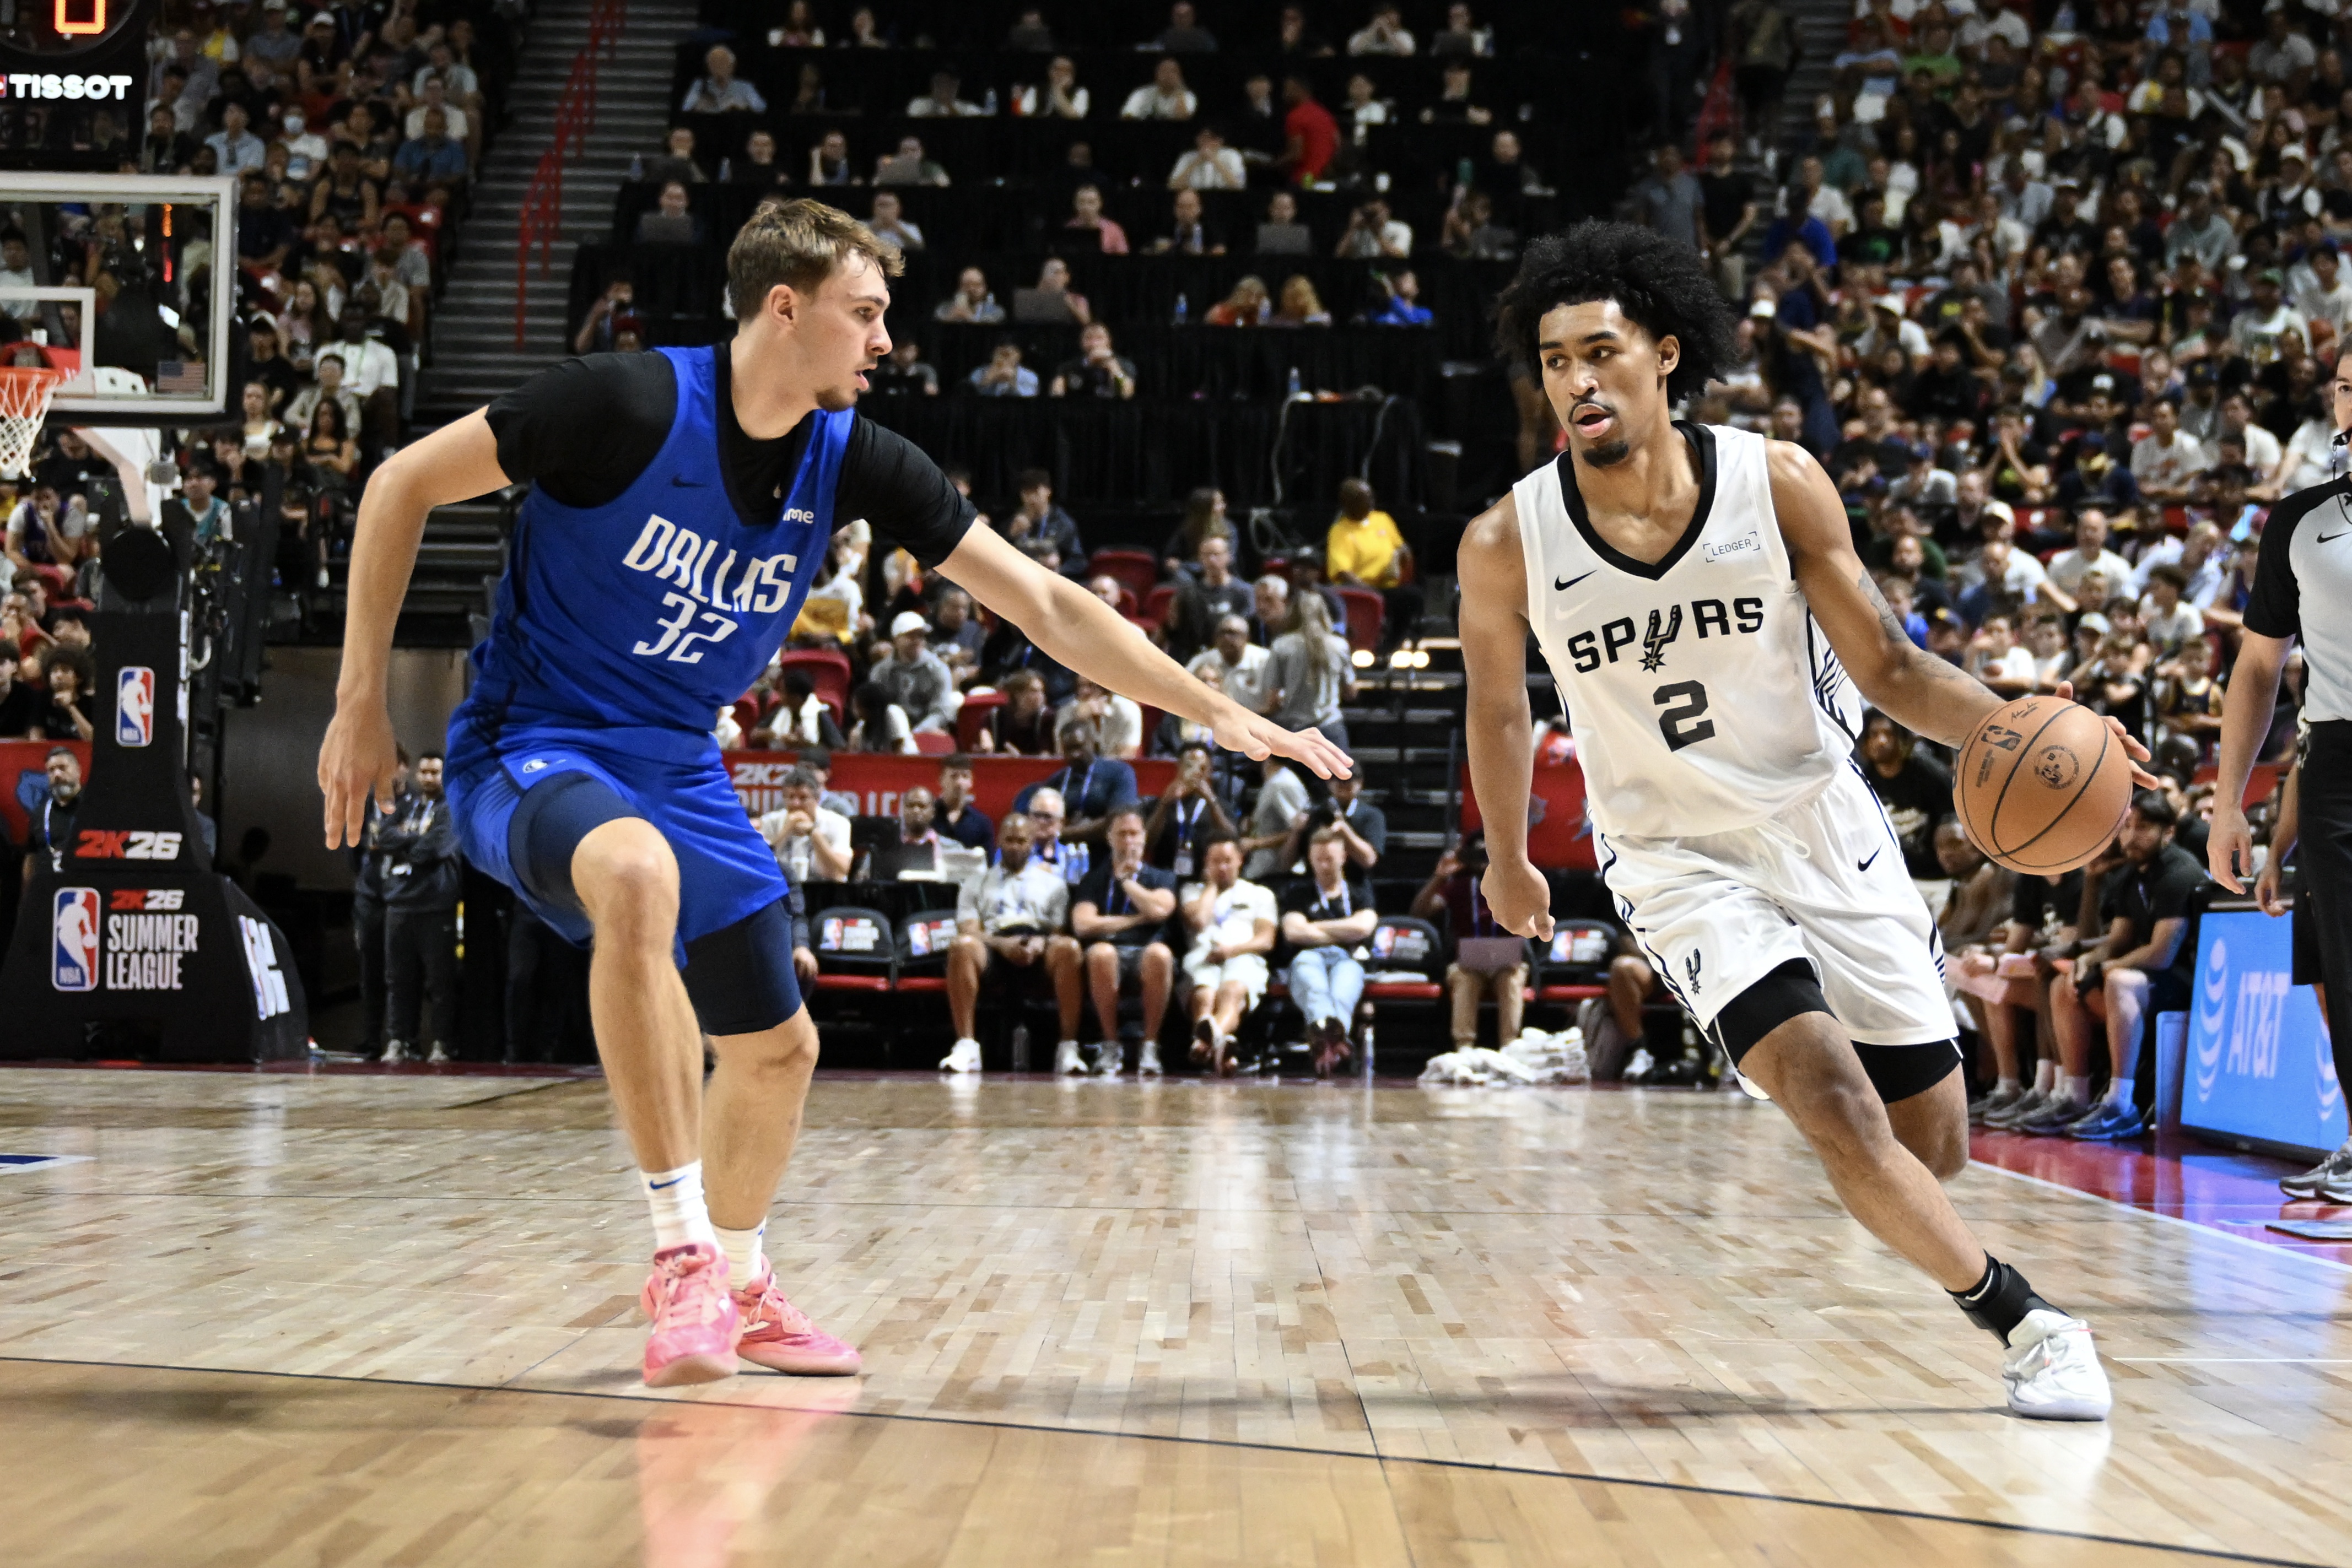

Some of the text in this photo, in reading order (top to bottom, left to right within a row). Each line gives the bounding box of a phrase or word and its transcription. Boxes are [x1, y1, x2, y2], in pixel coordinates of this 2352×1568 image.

[9, 73, 132, 100] TISSOT
[622, 514, 797, 613] DALLAS
[1712, 539, 1751, 556] LEDGER
[633, 592, 738, 663] 32
[1568, 598, 1763, 673] SPURS
[1653, 680, 1716, 752] 2
[732, 763, 795, 785] 2K2
[75, 829, 183, 859] 2K26
[110, 889, 185, 910] 2K26
[107, 913, 198, 952] SUMMER
[106, 952, 183, 990] LEAGUE
[2225, 971, 2291, 1079] AT&T
